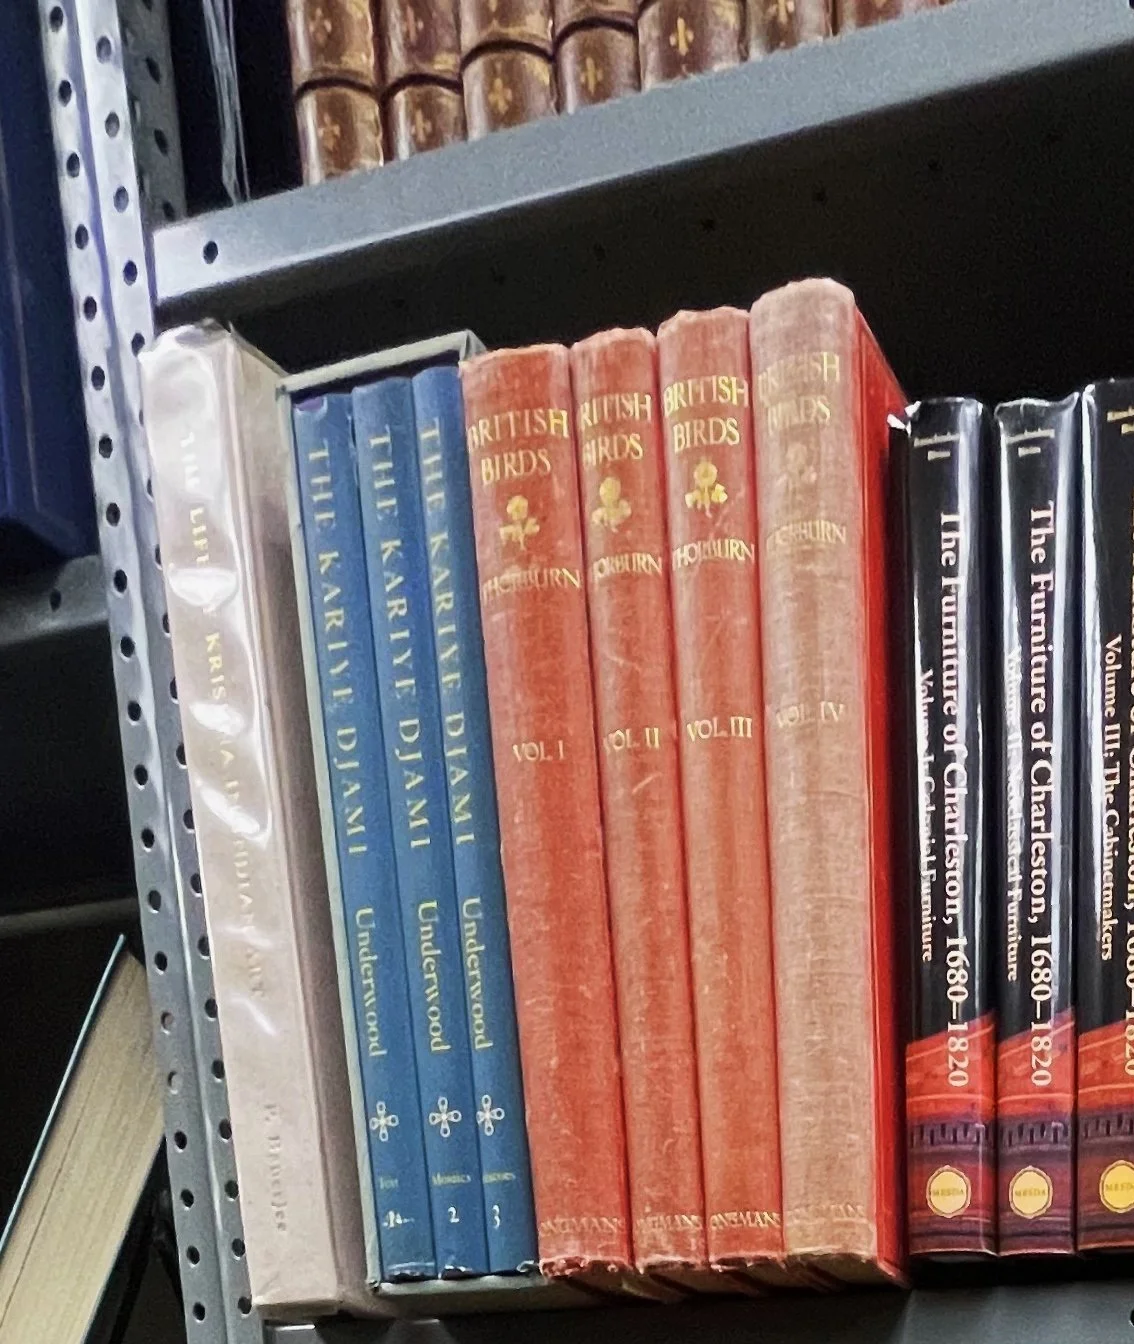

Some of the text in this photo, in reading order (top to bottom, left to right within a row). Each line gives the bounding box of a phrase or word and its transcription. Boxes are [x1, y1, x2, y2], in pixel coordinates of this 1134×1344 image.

[664, 375, 749, 418] BRITISH
[467, 408, 569, 452] BRITISH
[583, 433, 643, 466] BIRDS
[673, 417, 740, 454] BIRDS
[481, 448, 551, 485] BIRDS
[671, 538, 755, 571] THORBURN
[941, 512, 961, 567] The
[482, 567, 582, 600] THORBURN
[308, 444, 367, 855] THE KARIYE DJAMI
[369, 424, 431, 849] THE KARIYE DJAMI
[420, 417, 475, 845] THE KARIYE DJAMI
[941, 575, 964, 717] Furniture
[730, 716, 753, 738] III
[819, 702, 845, 723] IV
[1028, 500, 1055, 924] The Furniture of Charleston,
[644, 727, 660, 750] II
[943, 722, 968, 752] of
[1100, 634, 1124, 962] Volume The Cabinetmakers
[355, 908, 387, 1057] Underwood
[418, 901, 451, 1053] Underwood
[461, 897, 493, 1050] Underwood
[448, 1207, 459, 1223] 2
